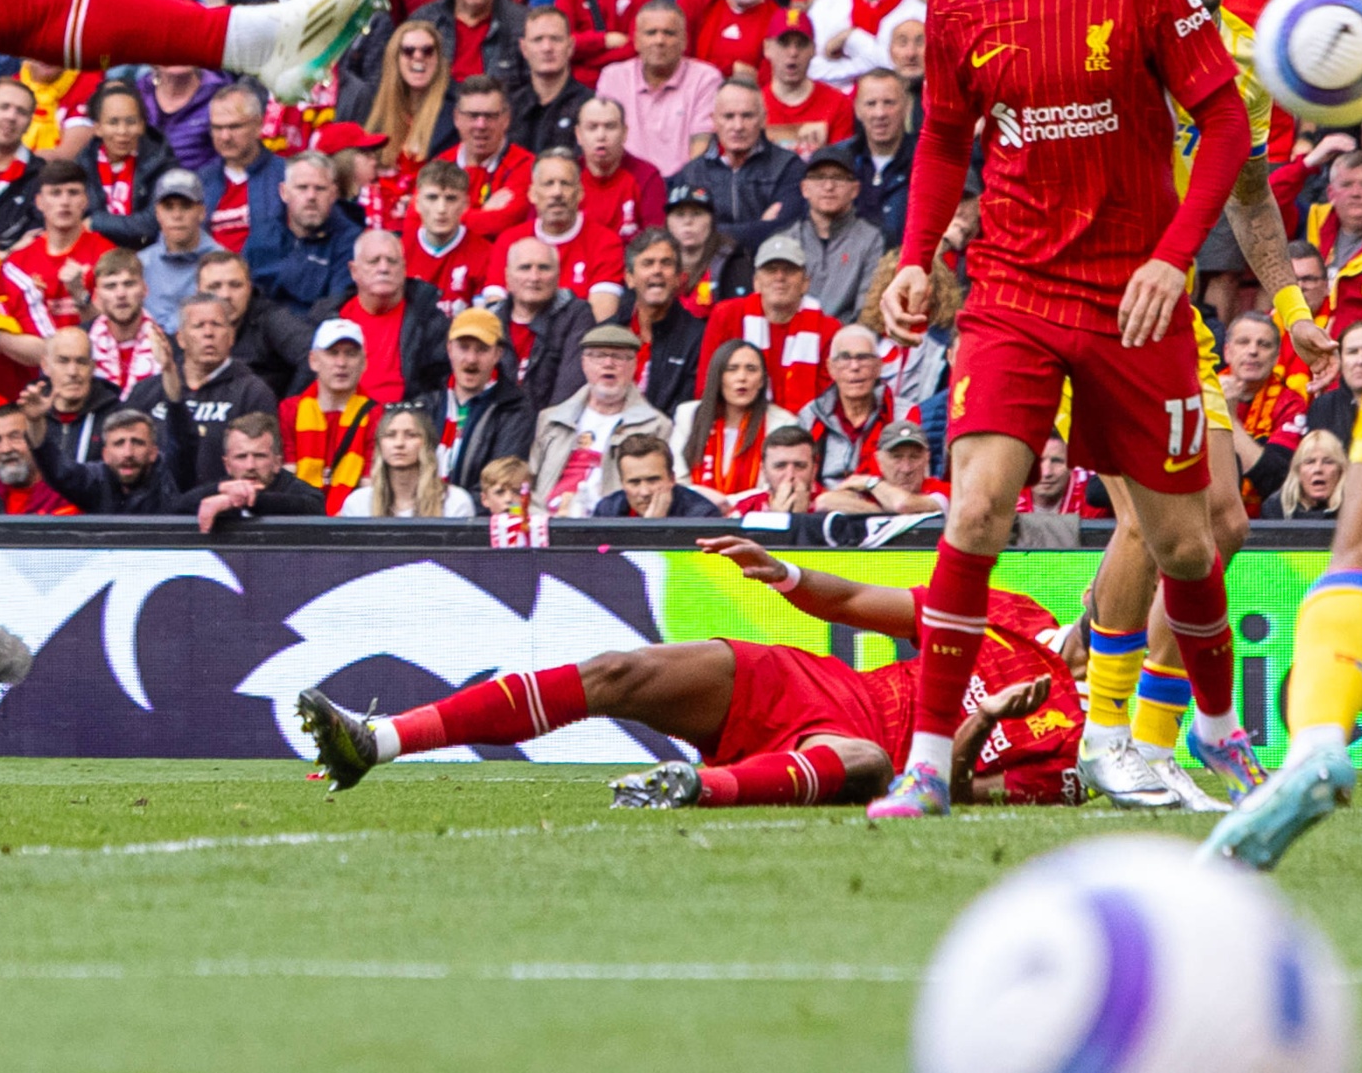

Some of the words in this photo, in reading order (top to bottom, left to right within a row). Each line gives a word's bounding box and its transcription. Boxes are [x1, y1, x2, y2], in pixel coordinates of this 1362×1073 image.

[1174, 7, 1212, 38] Expe
[1021, 98, 1113, 125] standard
[1022, 114, 1119, 143] chartered
[1165, 395, 1205, 457] 17
